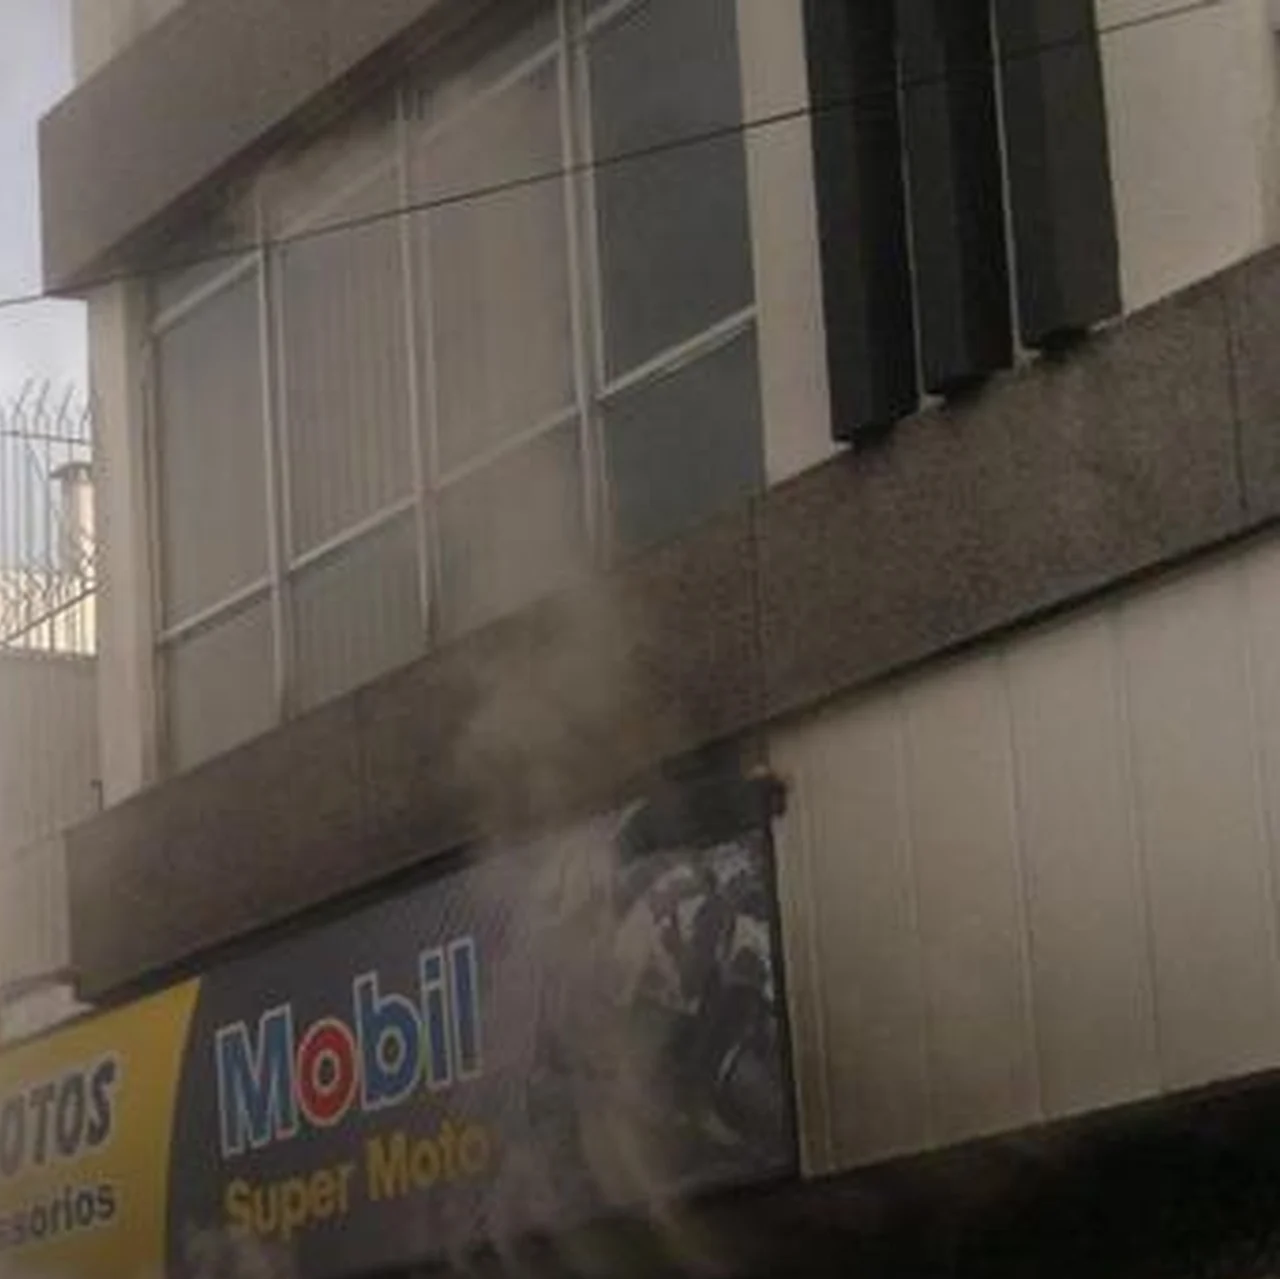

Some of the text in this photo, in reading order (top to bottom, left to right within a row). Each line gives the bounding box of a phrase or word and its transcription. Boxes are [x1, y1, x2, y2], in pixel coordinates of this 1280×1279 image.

[215, 937, 483, 1158] Mobil
[224, 1115, 502, 1240] Super Moto
